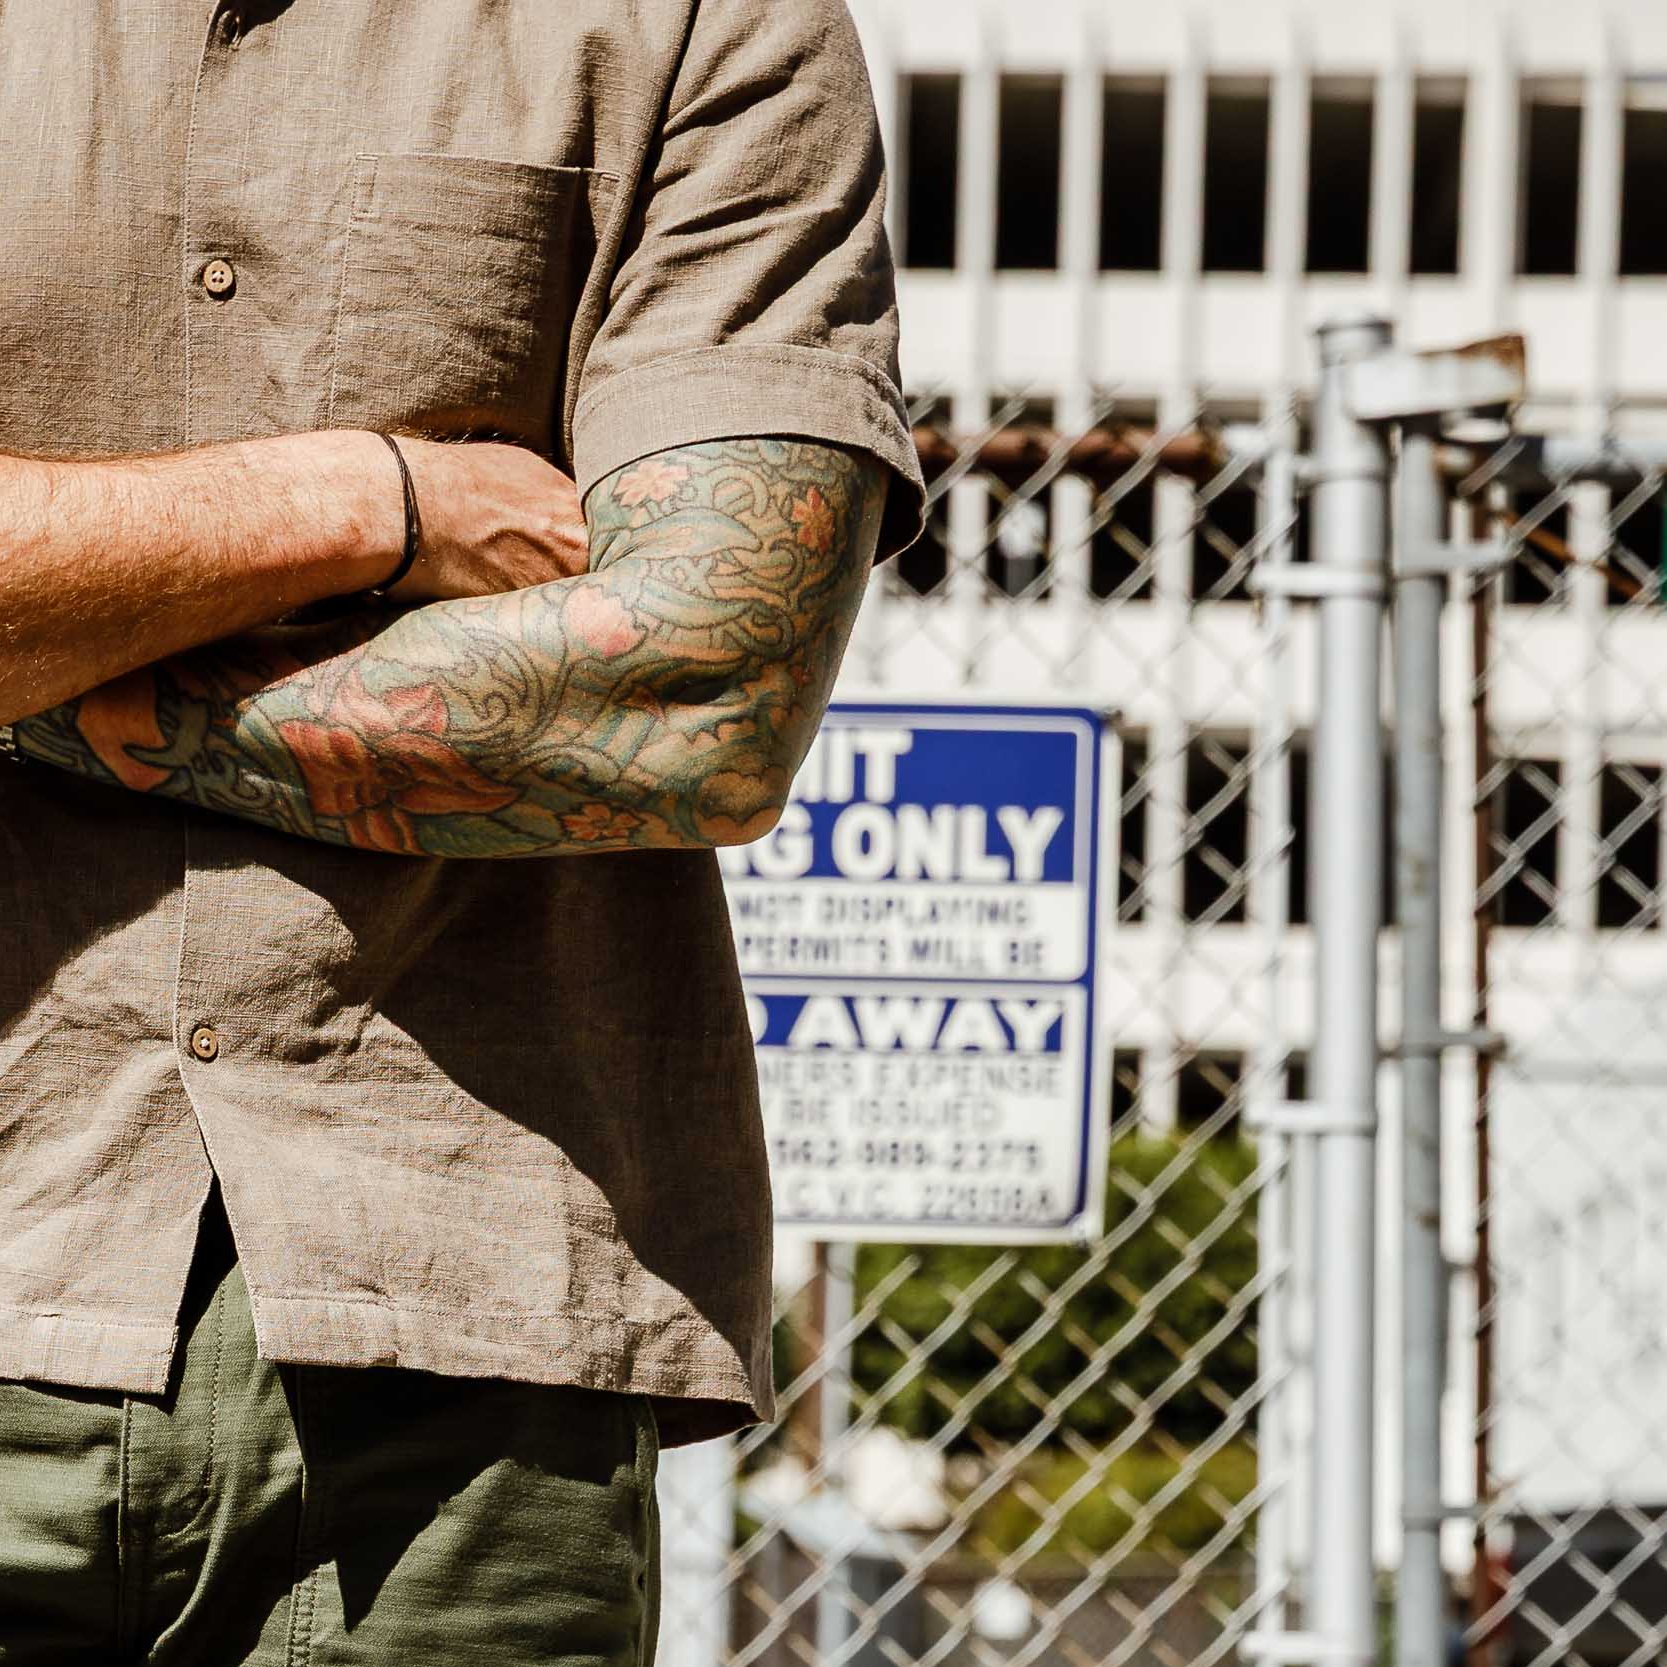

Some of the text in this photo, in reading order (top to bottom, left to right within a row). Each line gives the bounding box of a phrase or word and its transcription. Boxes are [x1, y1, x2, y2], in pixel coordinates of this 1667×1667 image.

[832, 802, 1065, 882] ONLY
[737, 894, 1031, 926] NOT DISPLAYING
[739, 933, 1047, 970] PERMITS WILL BE
[784, 994, 1063, 1052] AWAY
[874, 1058, 1061, 1094] EXPENSE
[853, 1096, 1000, 1130] ISSUED
